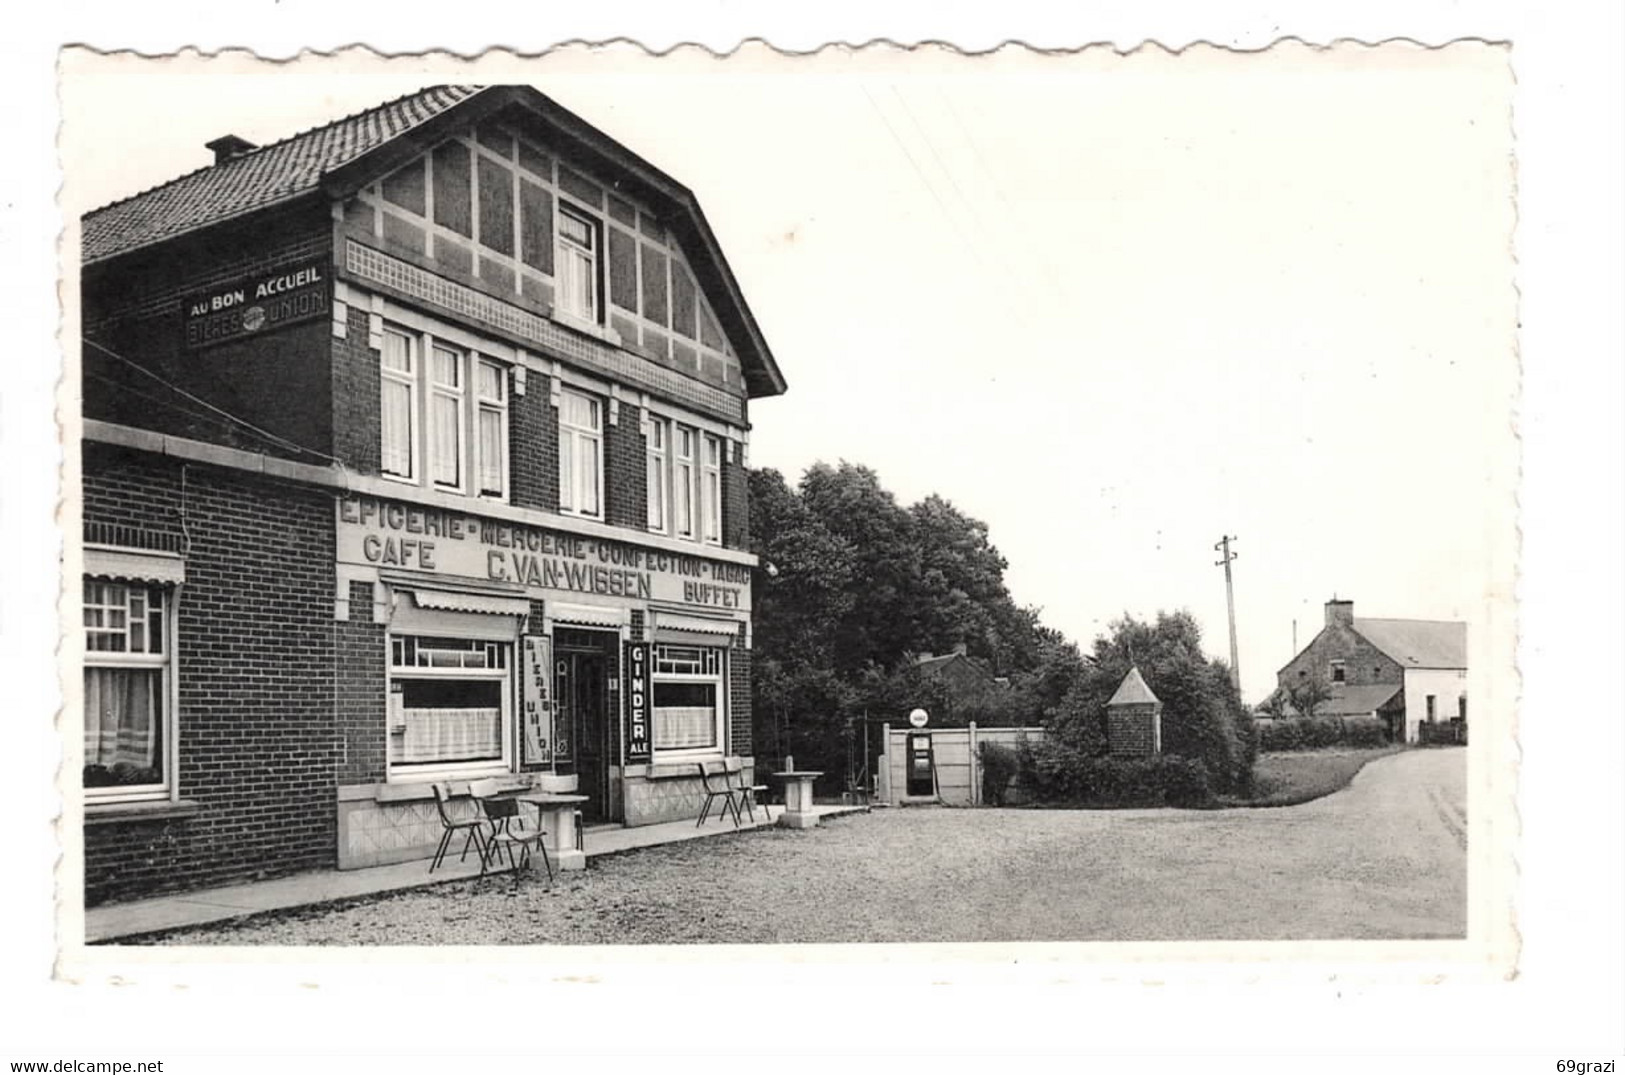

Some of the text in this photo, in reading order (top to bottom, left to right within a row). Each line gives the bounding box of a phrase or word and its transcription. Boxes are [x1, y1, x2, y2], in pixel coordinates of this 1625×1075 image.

[191, 267, 322, 317] AU BON ACCUEIL
[270, 291, 324, 322] UNION
[340, 498, 750, 585] EPICERIE MERCERIE CONFECTION TABAC
[363, 534, 435, 570] CAFE
[683, 580, 741, 608] BUFFET
[632, 647, 644, 739] GINDER
[629, 742, 649, 754] ALE
